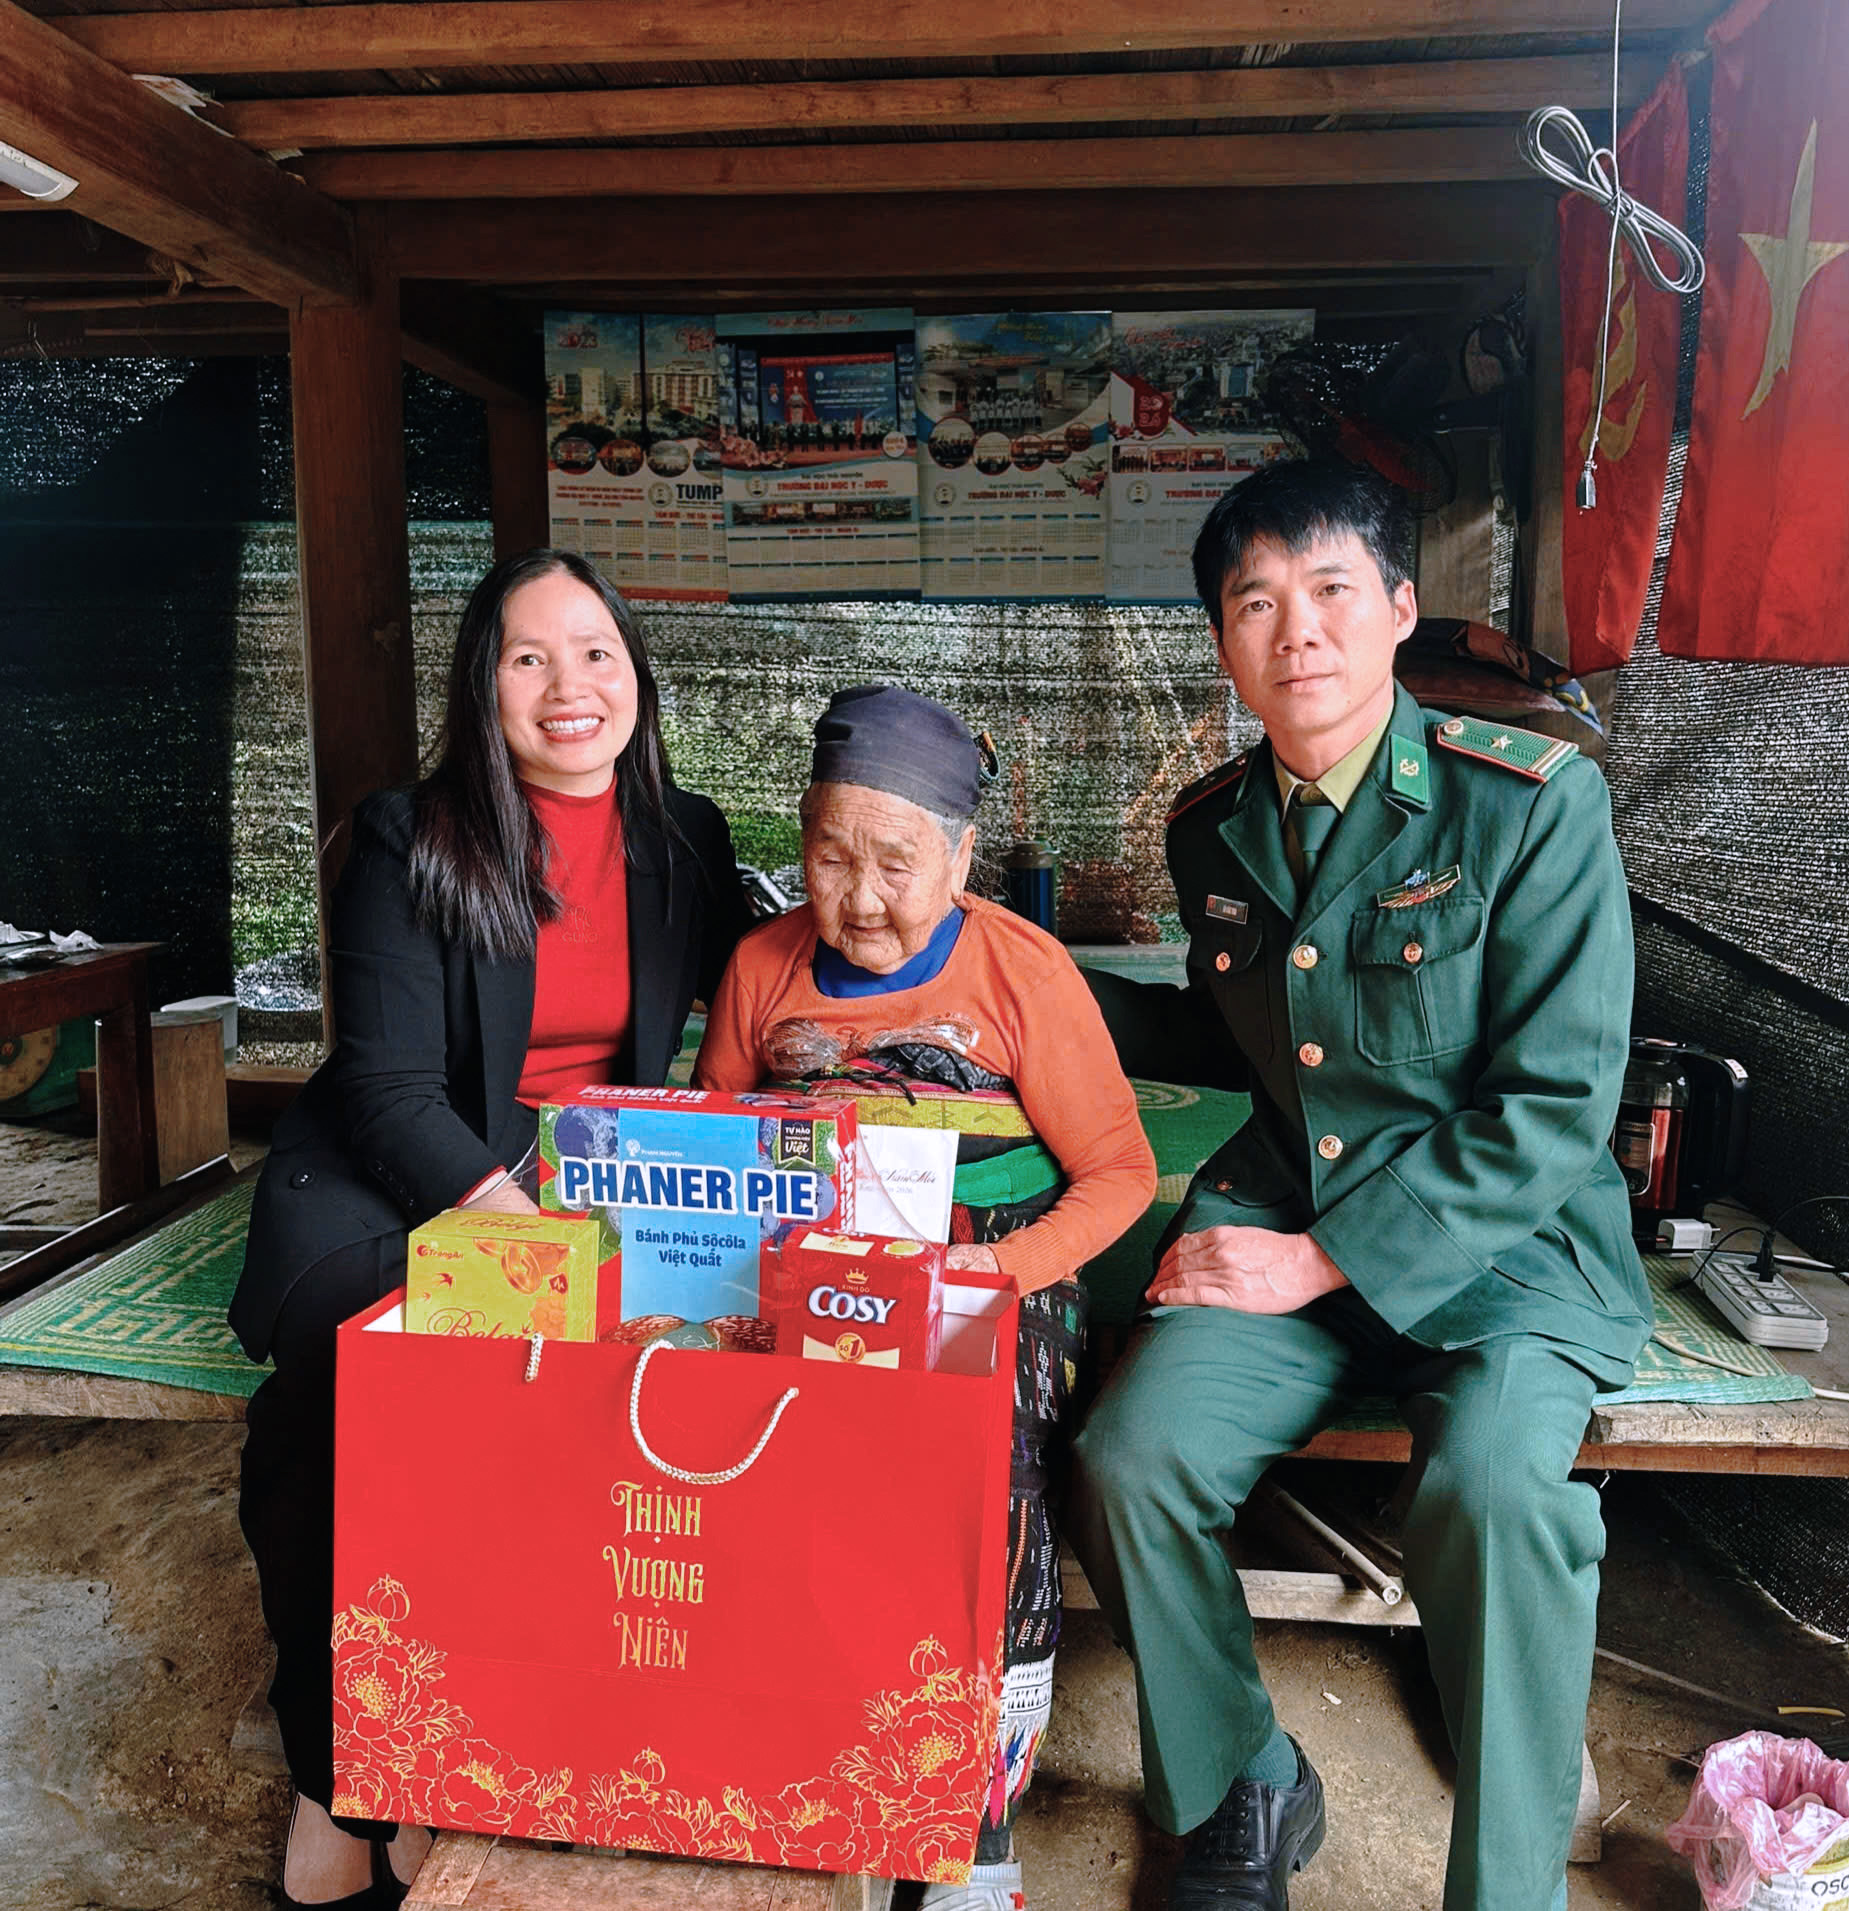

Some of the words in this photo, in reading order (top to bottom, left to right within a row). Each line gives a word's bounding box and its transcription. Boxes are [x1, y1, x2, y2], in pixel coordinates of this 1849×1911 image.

[676, 484, 723, 500] TUMP
[578, 1085, 669, 1097] PHANER
[672, 1089, 711, 1100] PIE
[561, 1158, 737, 1213] PHANER
[745, 1170, 816, 1218] PIE
[635, 1229, 669, 1244] Bánh
[673, 1230, 699, 1246] Phủ
[701, 1232, 746, 1249] Sôcôla
[659, 1250, 687, 1268] Việt
[689, 1248, 722, 1268] Quất
[808, 1285, 897, 1324] COSY
